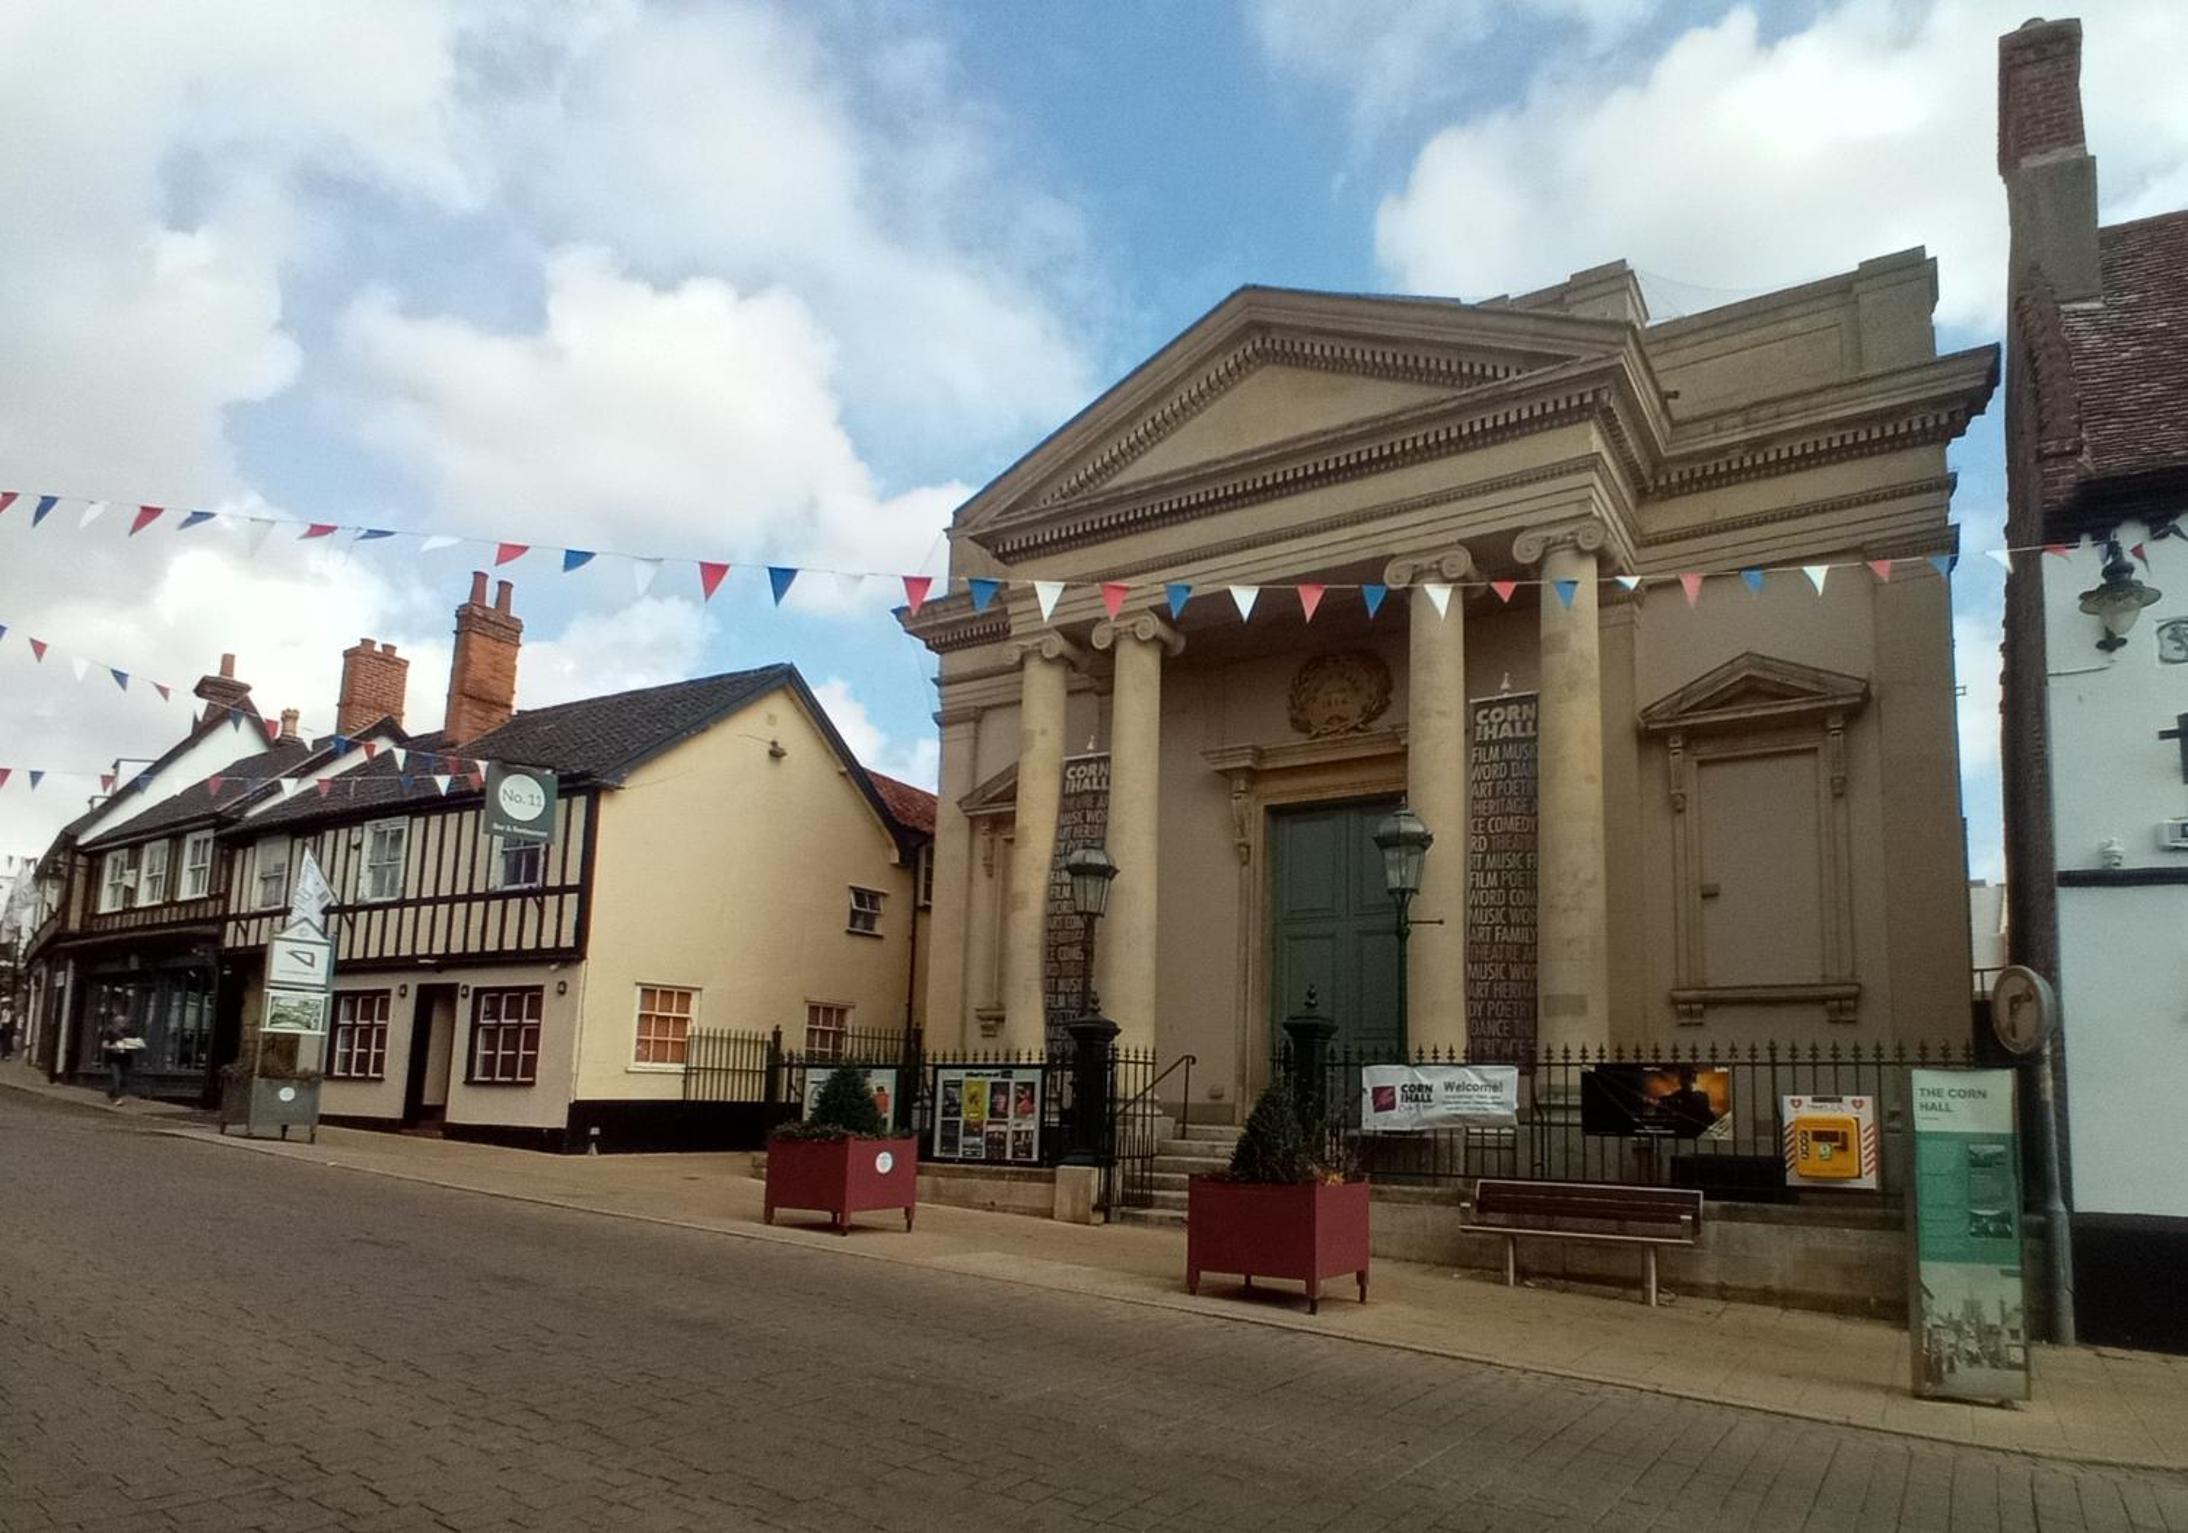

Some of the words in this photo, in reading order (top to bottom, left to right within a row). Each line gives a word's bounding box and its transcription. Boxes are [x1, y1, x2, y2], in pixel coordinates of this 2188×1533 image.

[1476, 703, 1537, 724] CORN
[1483, 721, 1537, 741] HALL
[1472, 744, 1500, 763] FILM
[1066, 764, 1109, 779] CORN
[1471, 762, 1508, 780] WORD
[1472, 781, 1493, 798] ART
[1472, 798, 1530, 817] HERITAGE
[1471, 818, 1485, 834] CE
[1485, 852, 1524, 870] MUSIC
[1470, 871, 1498, 888] FILM
[1469, 889, 1506, 906] WORD
[1469, 907, 1507, 925] MUSIC
[1467, 963, 1507, 980] MUSIC
[1471, 1019, 1510, 1038] DANCE
[1400, 1083, 1434, 1093] CORN
[1443, 1081, 1504, 1093] Welcome!
[1918, 1087, 1945, 1099] THE
[1948, 1088, 1988, 1100] CORN
[1919, 1101, 1954, 1113] HALL
